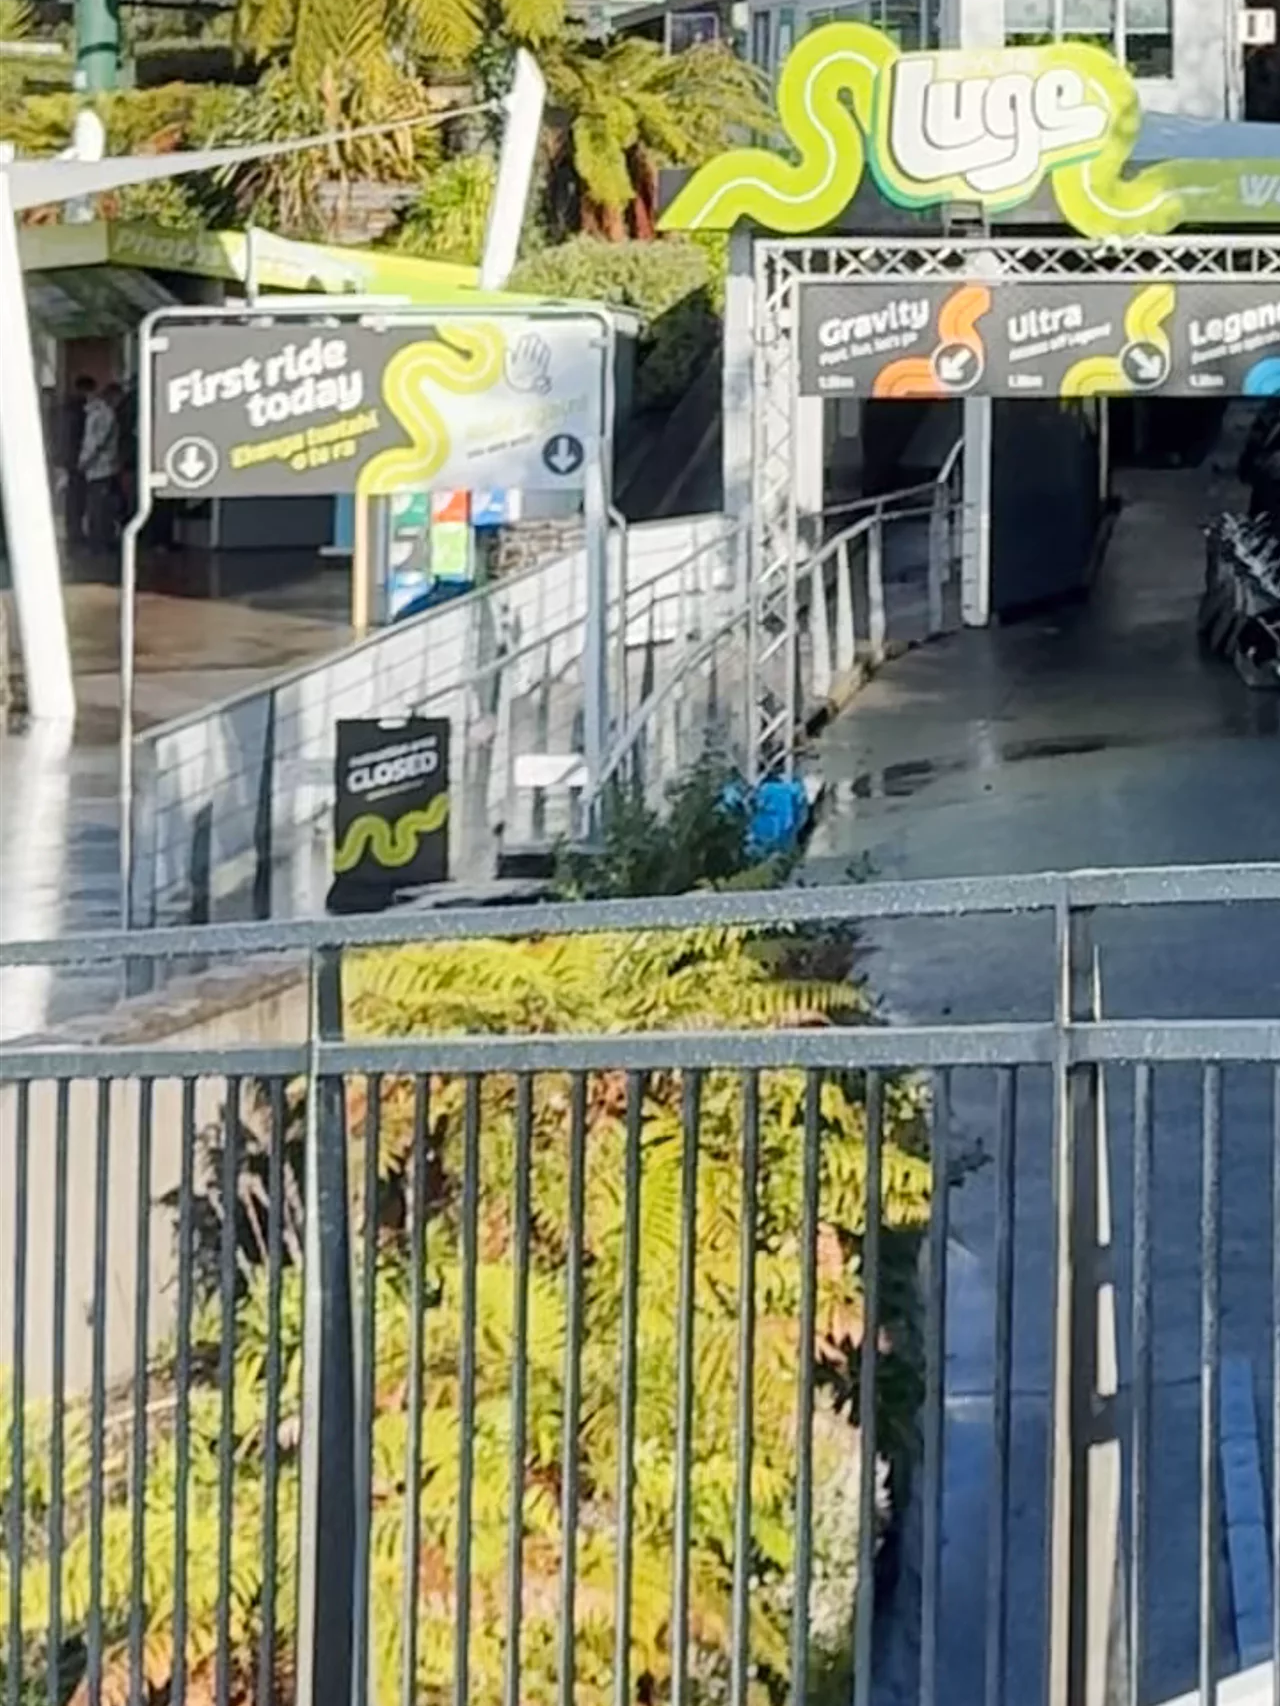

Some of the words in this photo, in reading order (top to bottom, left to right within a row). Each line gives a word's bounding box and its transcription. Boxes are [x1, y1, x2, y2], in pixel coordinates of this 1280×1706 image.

[891, 59, 1111, 193] Luge
[818, 298, 929, 347] Gravity
[1008, 304, 1083, 342] Ultra
[169, 357, 261, 414] First
[265, 337, 348, 386] ride
[245, 369, 364, 427] today
[347, 749, 439, 794] CLOSED
